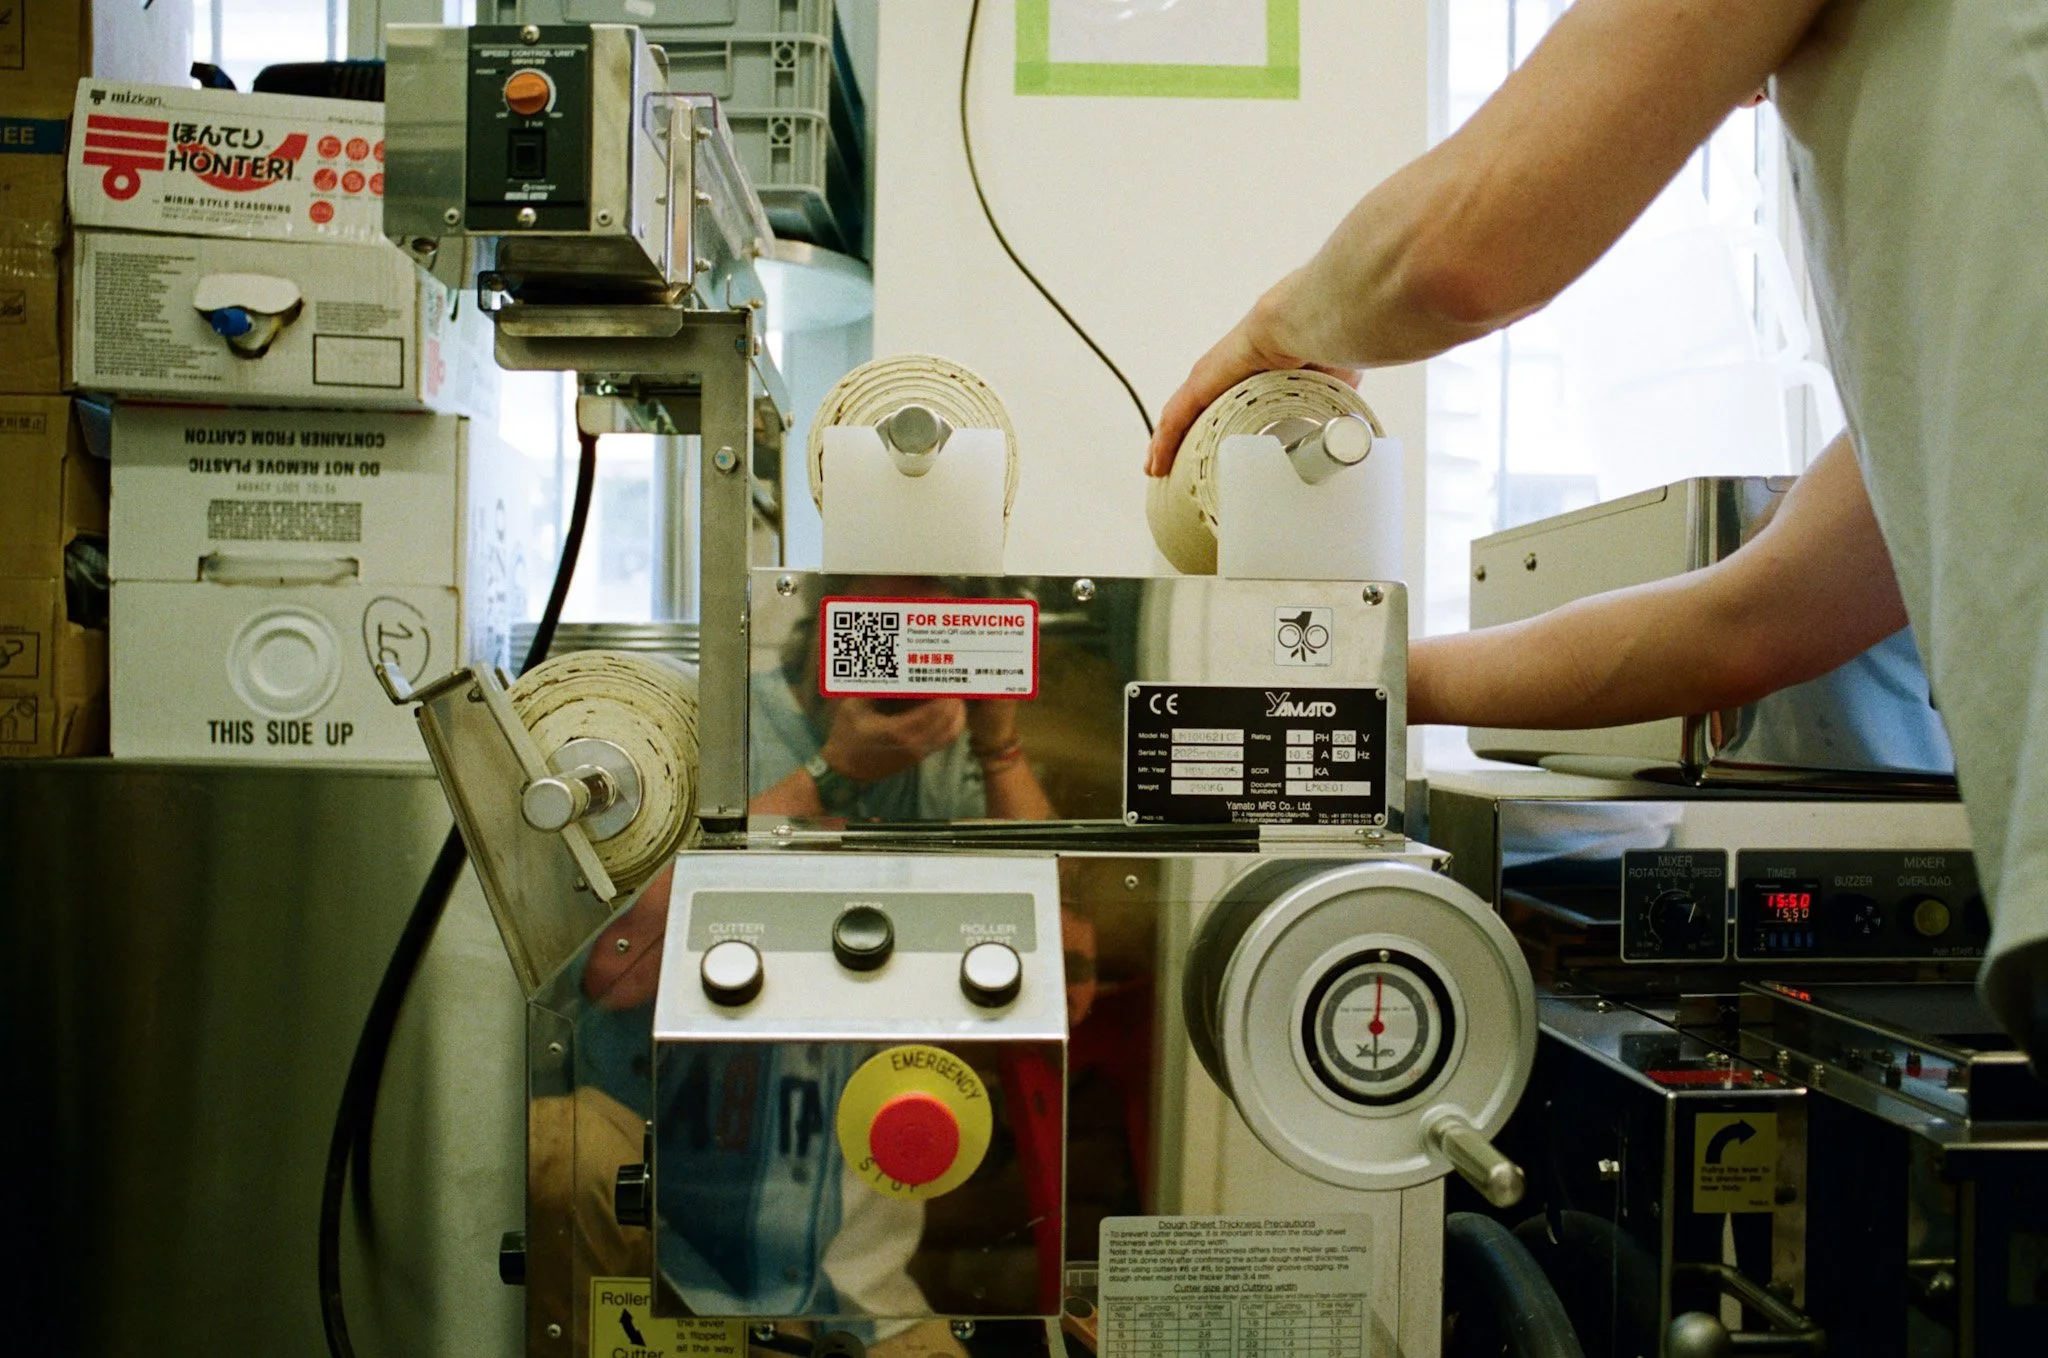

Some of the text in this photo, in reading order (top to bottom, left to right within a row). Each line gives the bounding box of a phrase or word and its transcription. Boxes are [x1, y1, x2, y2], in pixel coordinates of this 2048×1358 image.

[111, 90, 162, 107] mizkan
[0, 126, 35, 145] EE
[172, 122, 264, 150] ほんてり
[168, 149, 294, 181] HONTERI
[164, 195, 291, 214] MIRIN-STYLE SEASONING
[184, 429, 385, 449] CONTAINER FROM CARTON
[189, 457, 381, 477] DO NOT REMOVE PLASTIC
[907, 614, 1025, 627] FOR SERVICING
[1265, 691, 1336, 717] YAMATO
[207, 720, 354, 745] THIS SIDE UP
[1251, 733, 1271, 741] Rating
[1297, 734, 1301, 743] 1
[1315, 734, 1329, 742] PH
[1362, 734, 1370, 742] V
[1321, 750, 1329, 759] A
[1336, 751, 1350, 759] 50
[1357, 751, 1370, 759] Hz
[1297, 767, 1301, 775] 1
[1315, 768, 1329, 776] KA
[1226, 801, 1255, 810] Yamato
[1258, 801, 1276, 810] MFG
[1298, 801, 1312, 810] Ltd.
[1658, 855, 1693, 867] MIXER
[1904, 858, 1945, 868] MIXER
[1629, 868, 1722, 878] ROTATIONAL SPEED
[1767, 868, 1796, 878] TIMER
[1834, 876, 1873, 886] BUZZER
[1897, 876, 1951, 887] OVERLOAD
[1776, 908, 1809, 918] 15:50
[709, 924, 765, 934] CUTTER
[960, 924, 1017, 935] ROLLER
[891, 1051, 981, 1100] EMERGENCY
[1158, 1220, 1315, 1230] Dough Sheet Thickness Precautions
[1174, 1283, 1297, 1293] Cutter size and Cutting width
[602, 1292, 650, 1306] Roller
[676, 1331, 726, 1341] is flipped
[612, 1347, 664, 1358] Cutter
[676, 1344, 734, 1354] all the way
